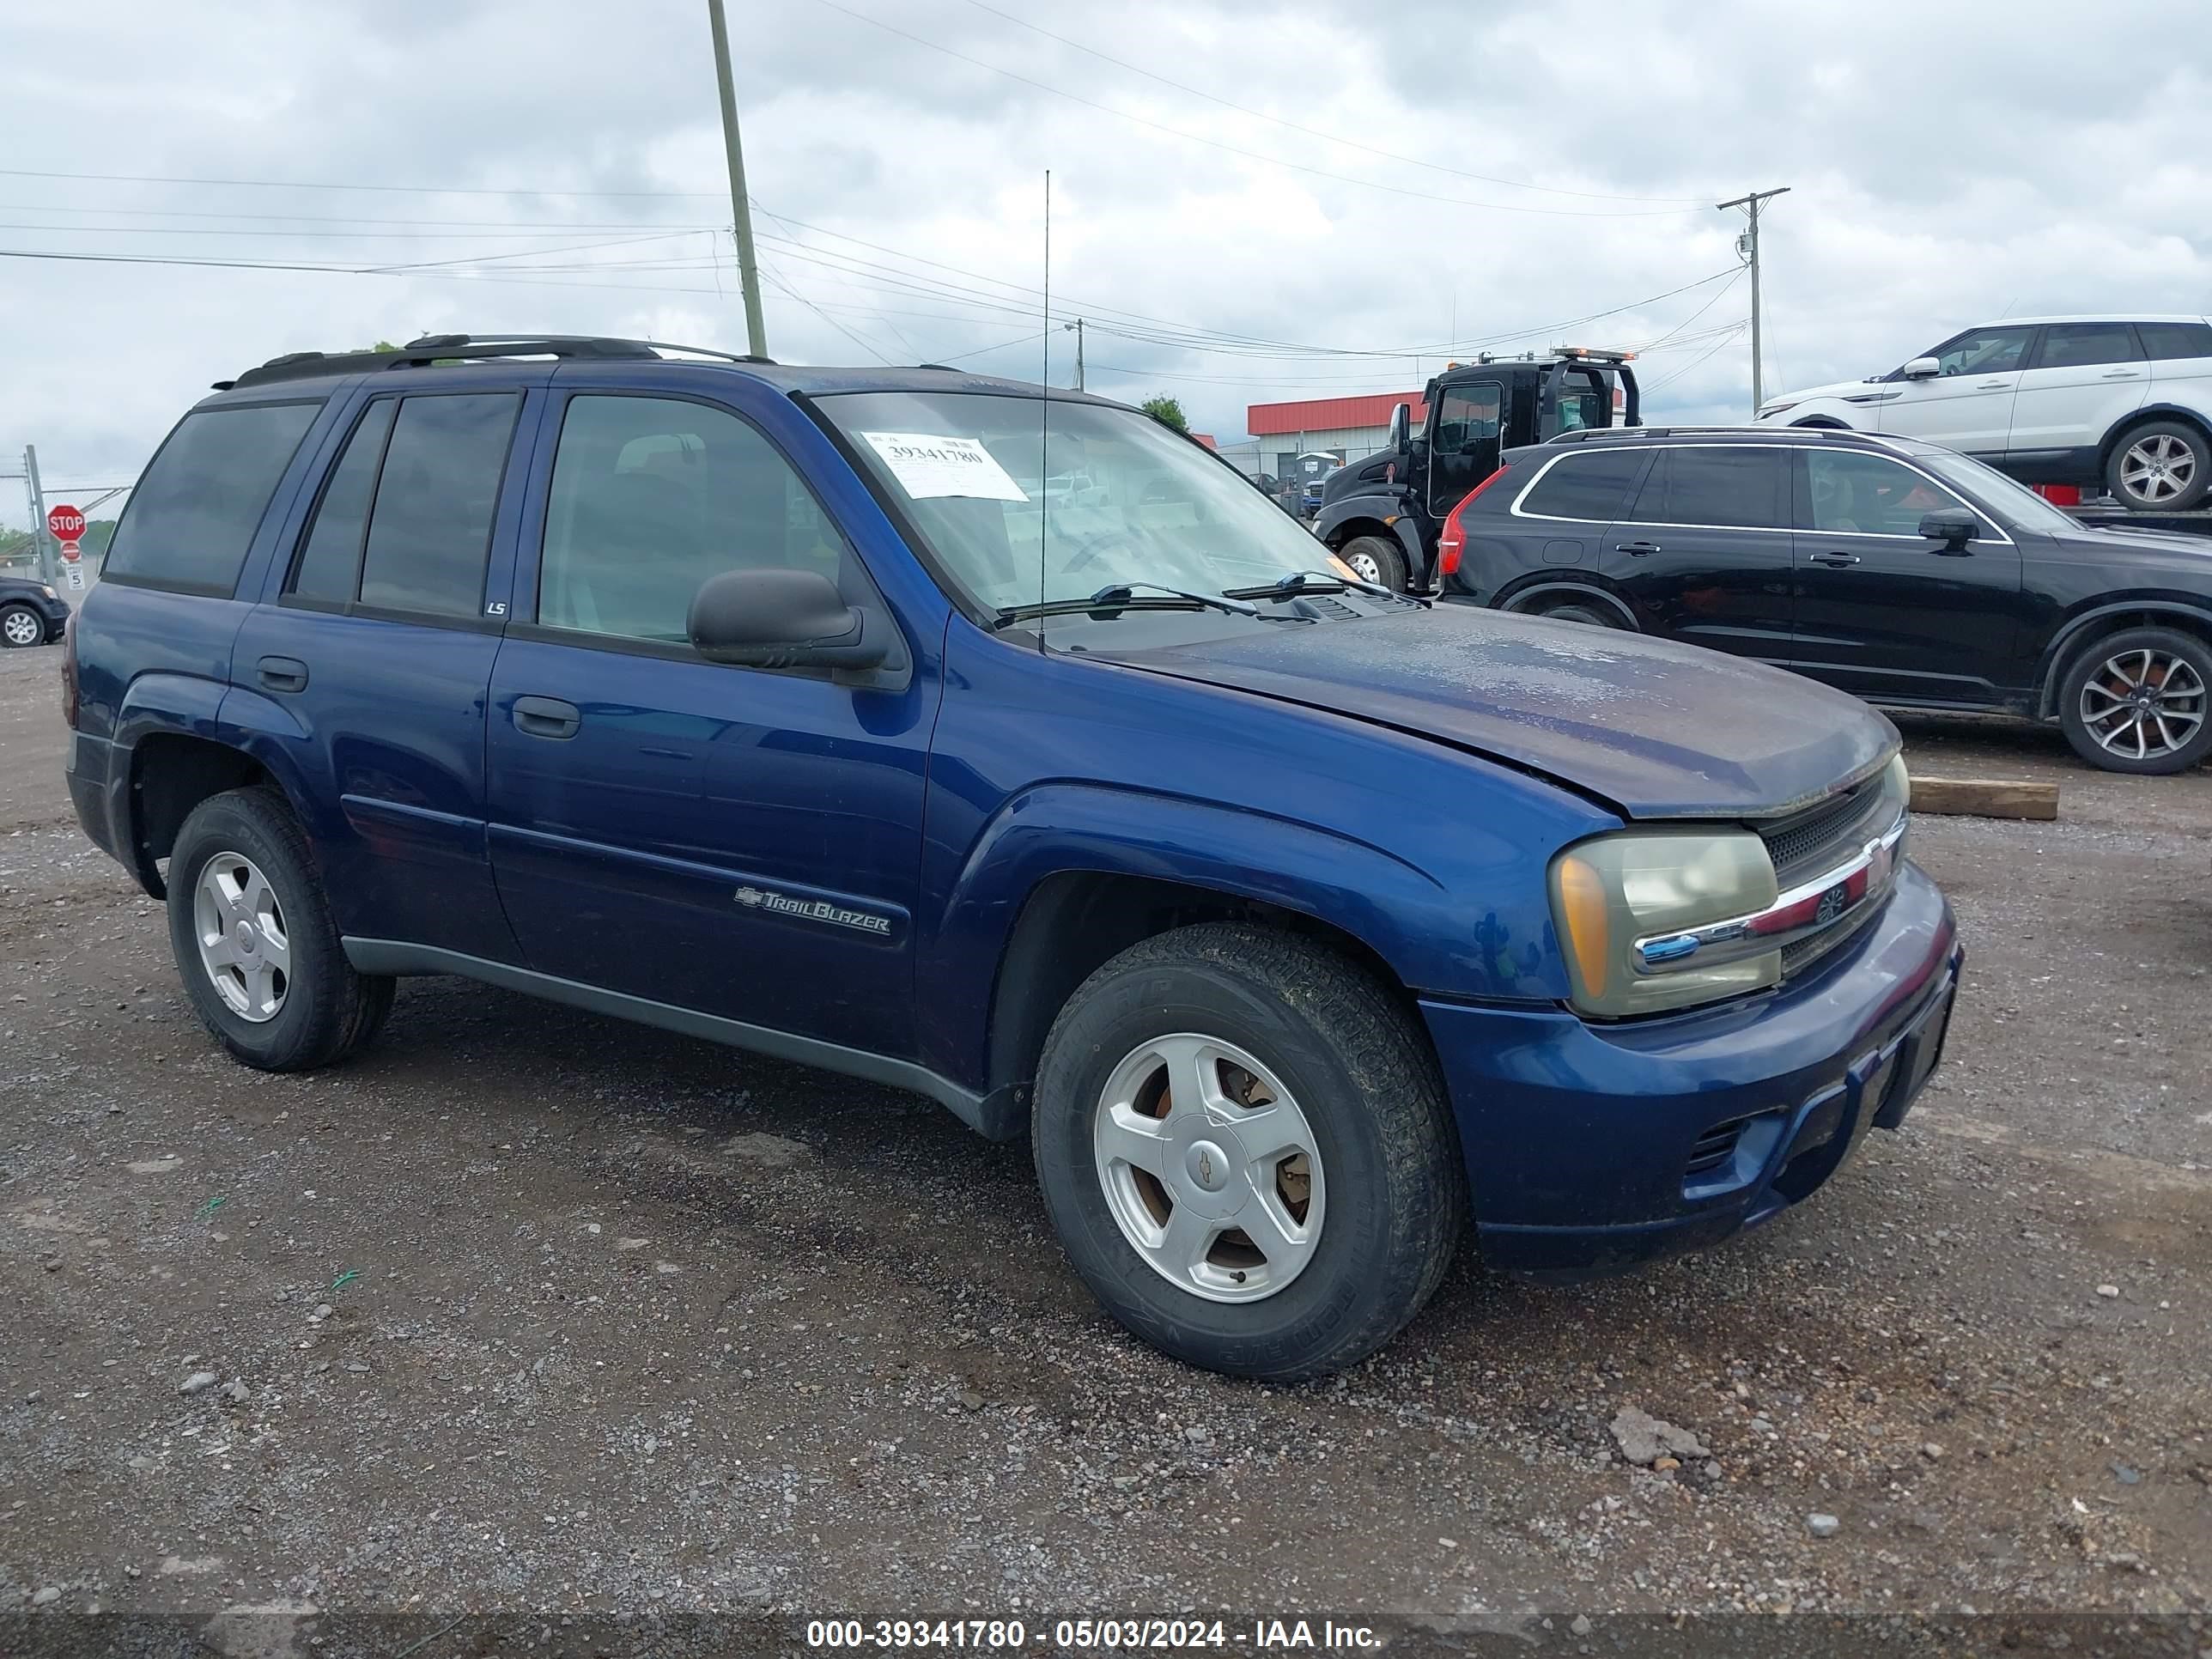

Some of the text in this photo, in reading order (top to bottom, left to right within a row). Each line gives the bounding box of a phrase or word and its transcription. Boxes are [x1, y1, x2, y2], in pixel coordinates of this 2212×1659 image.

[888, 446, 983, 464] 39341780
[50, 515, 83, 531] STOP
[72, 574, 81, 585] 5
[487, 602, 507, 615] LS
